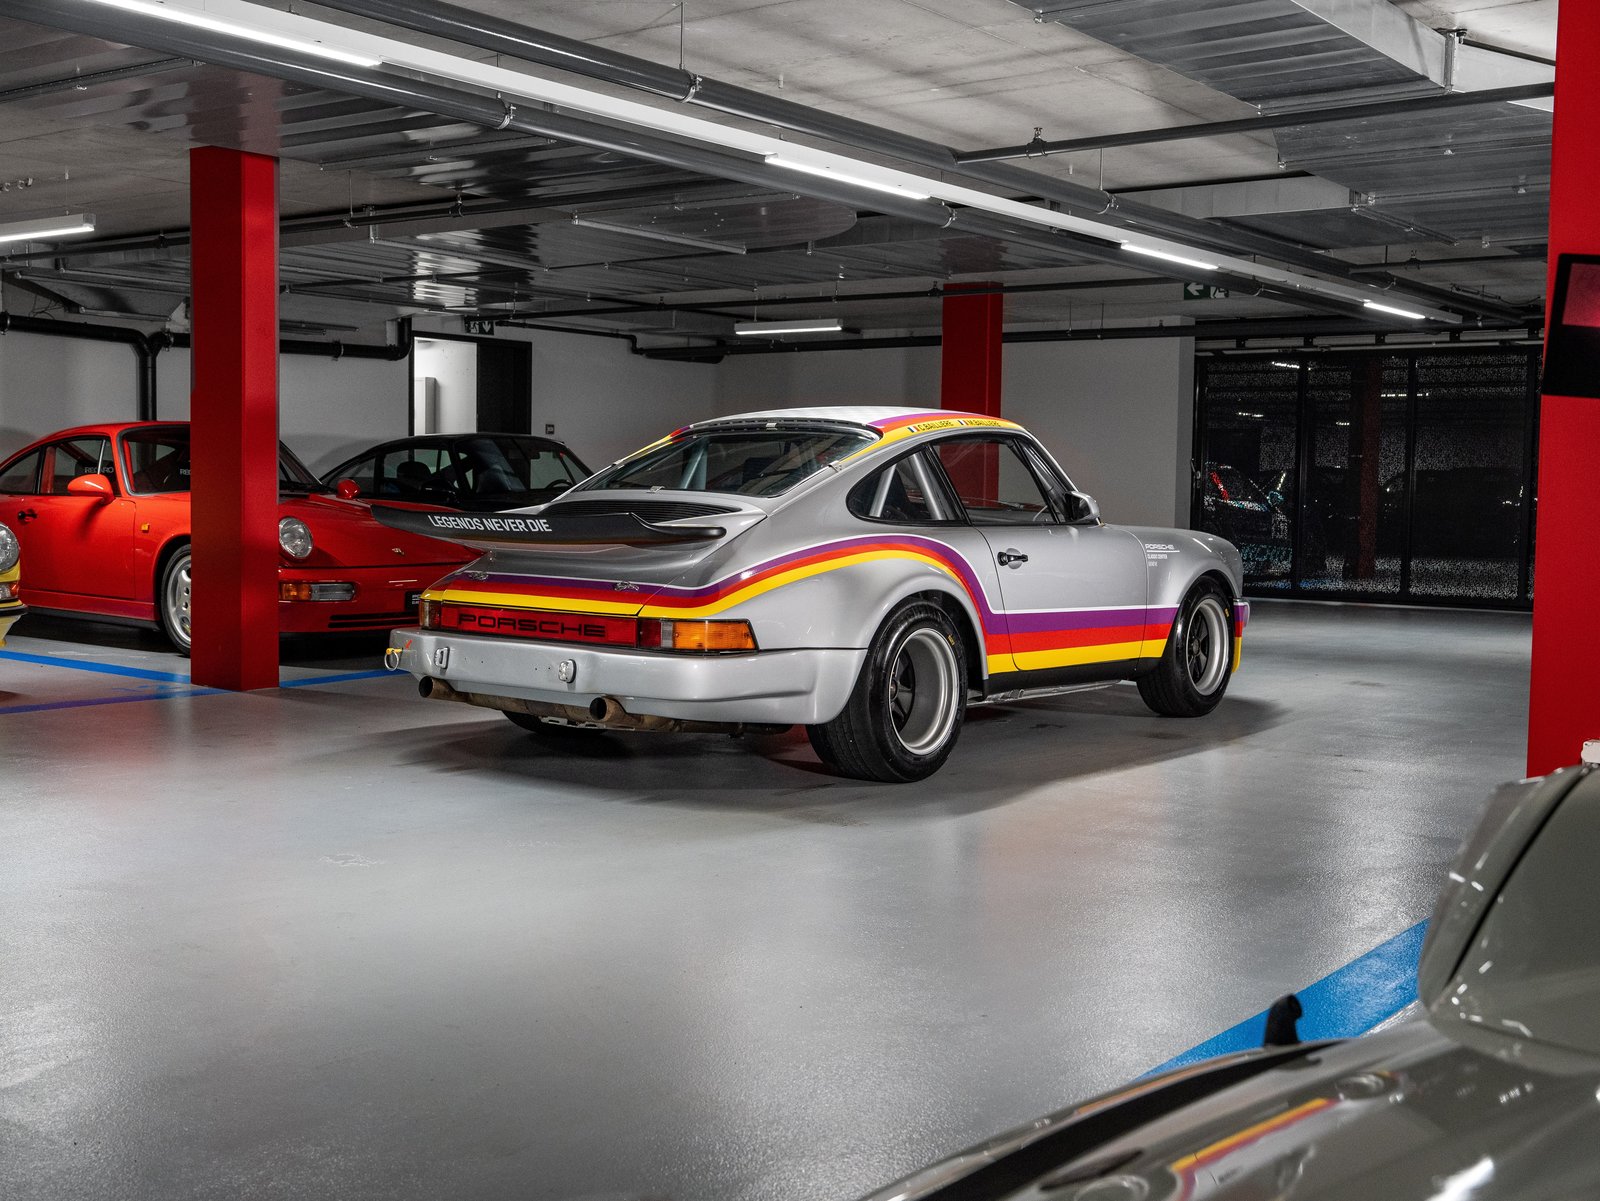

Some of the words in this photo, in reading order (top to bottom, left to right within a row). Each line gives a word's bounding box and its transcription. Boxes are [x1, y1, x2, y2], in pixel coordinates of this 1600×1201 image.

[427, 515, 485, 531] LEGENDS
[482, 518, 528, 532] NEVER
[526, 519, 553, 532] DIE
[458, 613, 606, 638] PORSCHE
